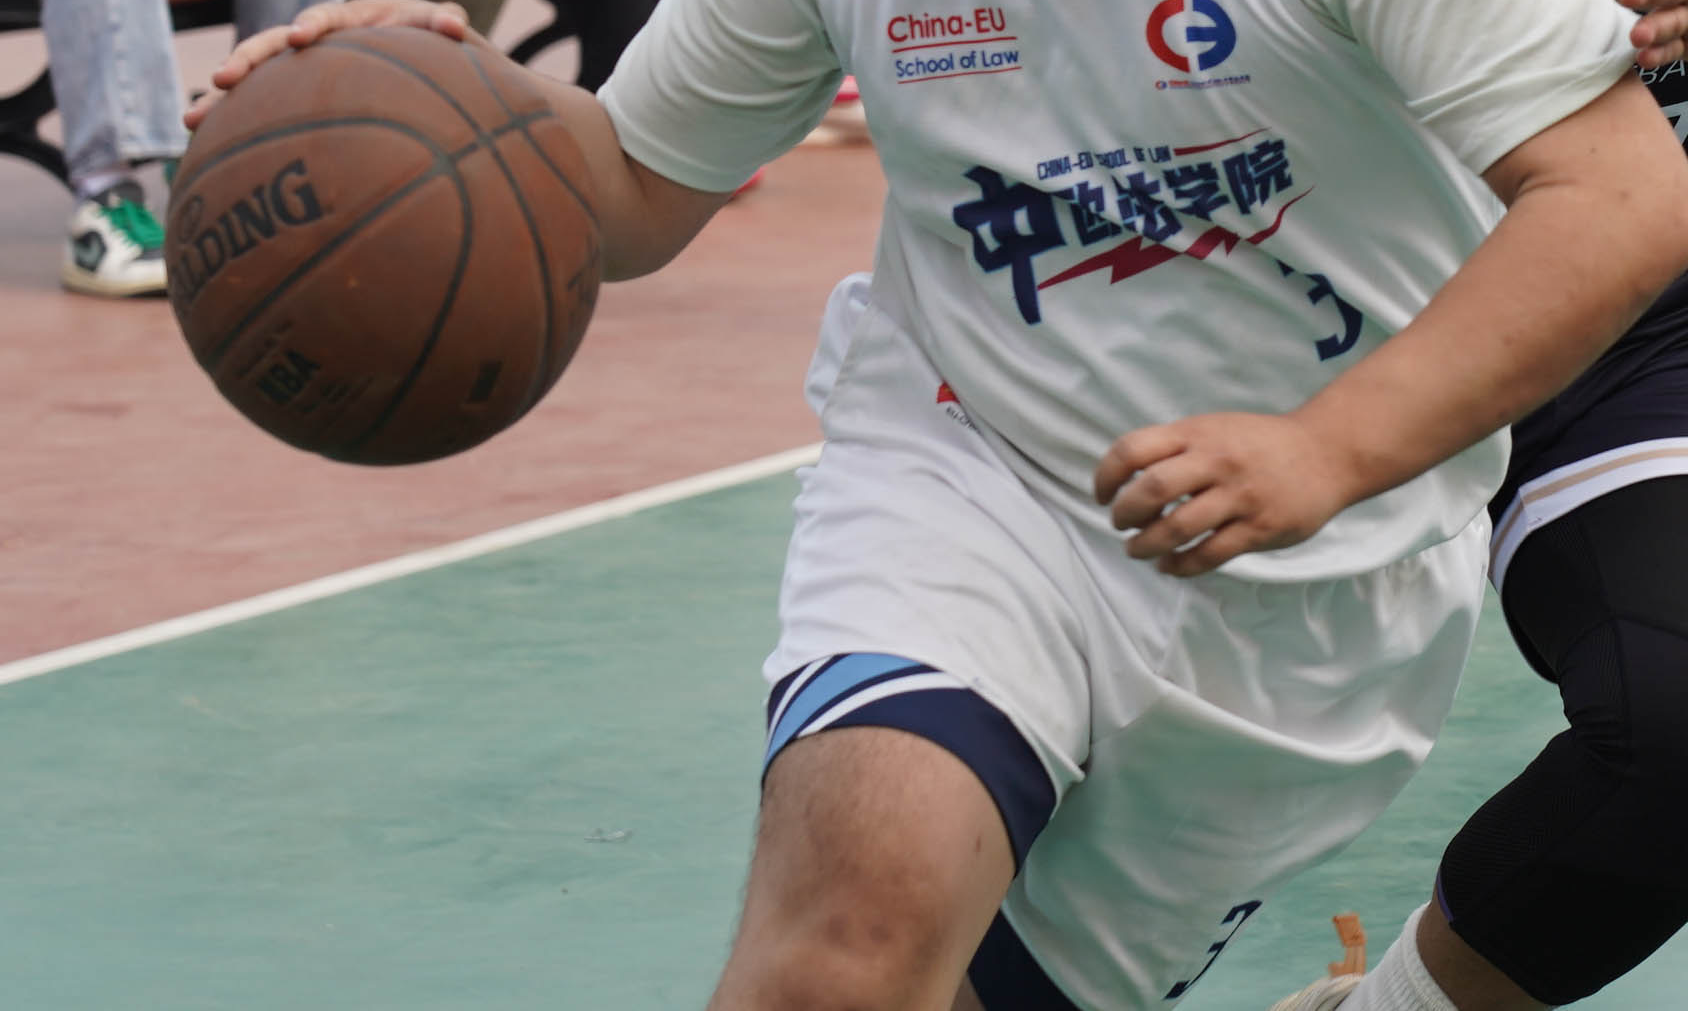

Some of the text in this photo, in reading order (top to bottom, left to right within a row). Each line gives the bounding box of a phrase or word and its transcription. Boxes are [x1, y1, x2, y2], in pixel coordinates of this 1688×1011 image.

[887, 6, 1007, 43] China-EU
[895, 49, 1019, 79] School of Law
[953, 139, 1294, 326] 中欧法学院
